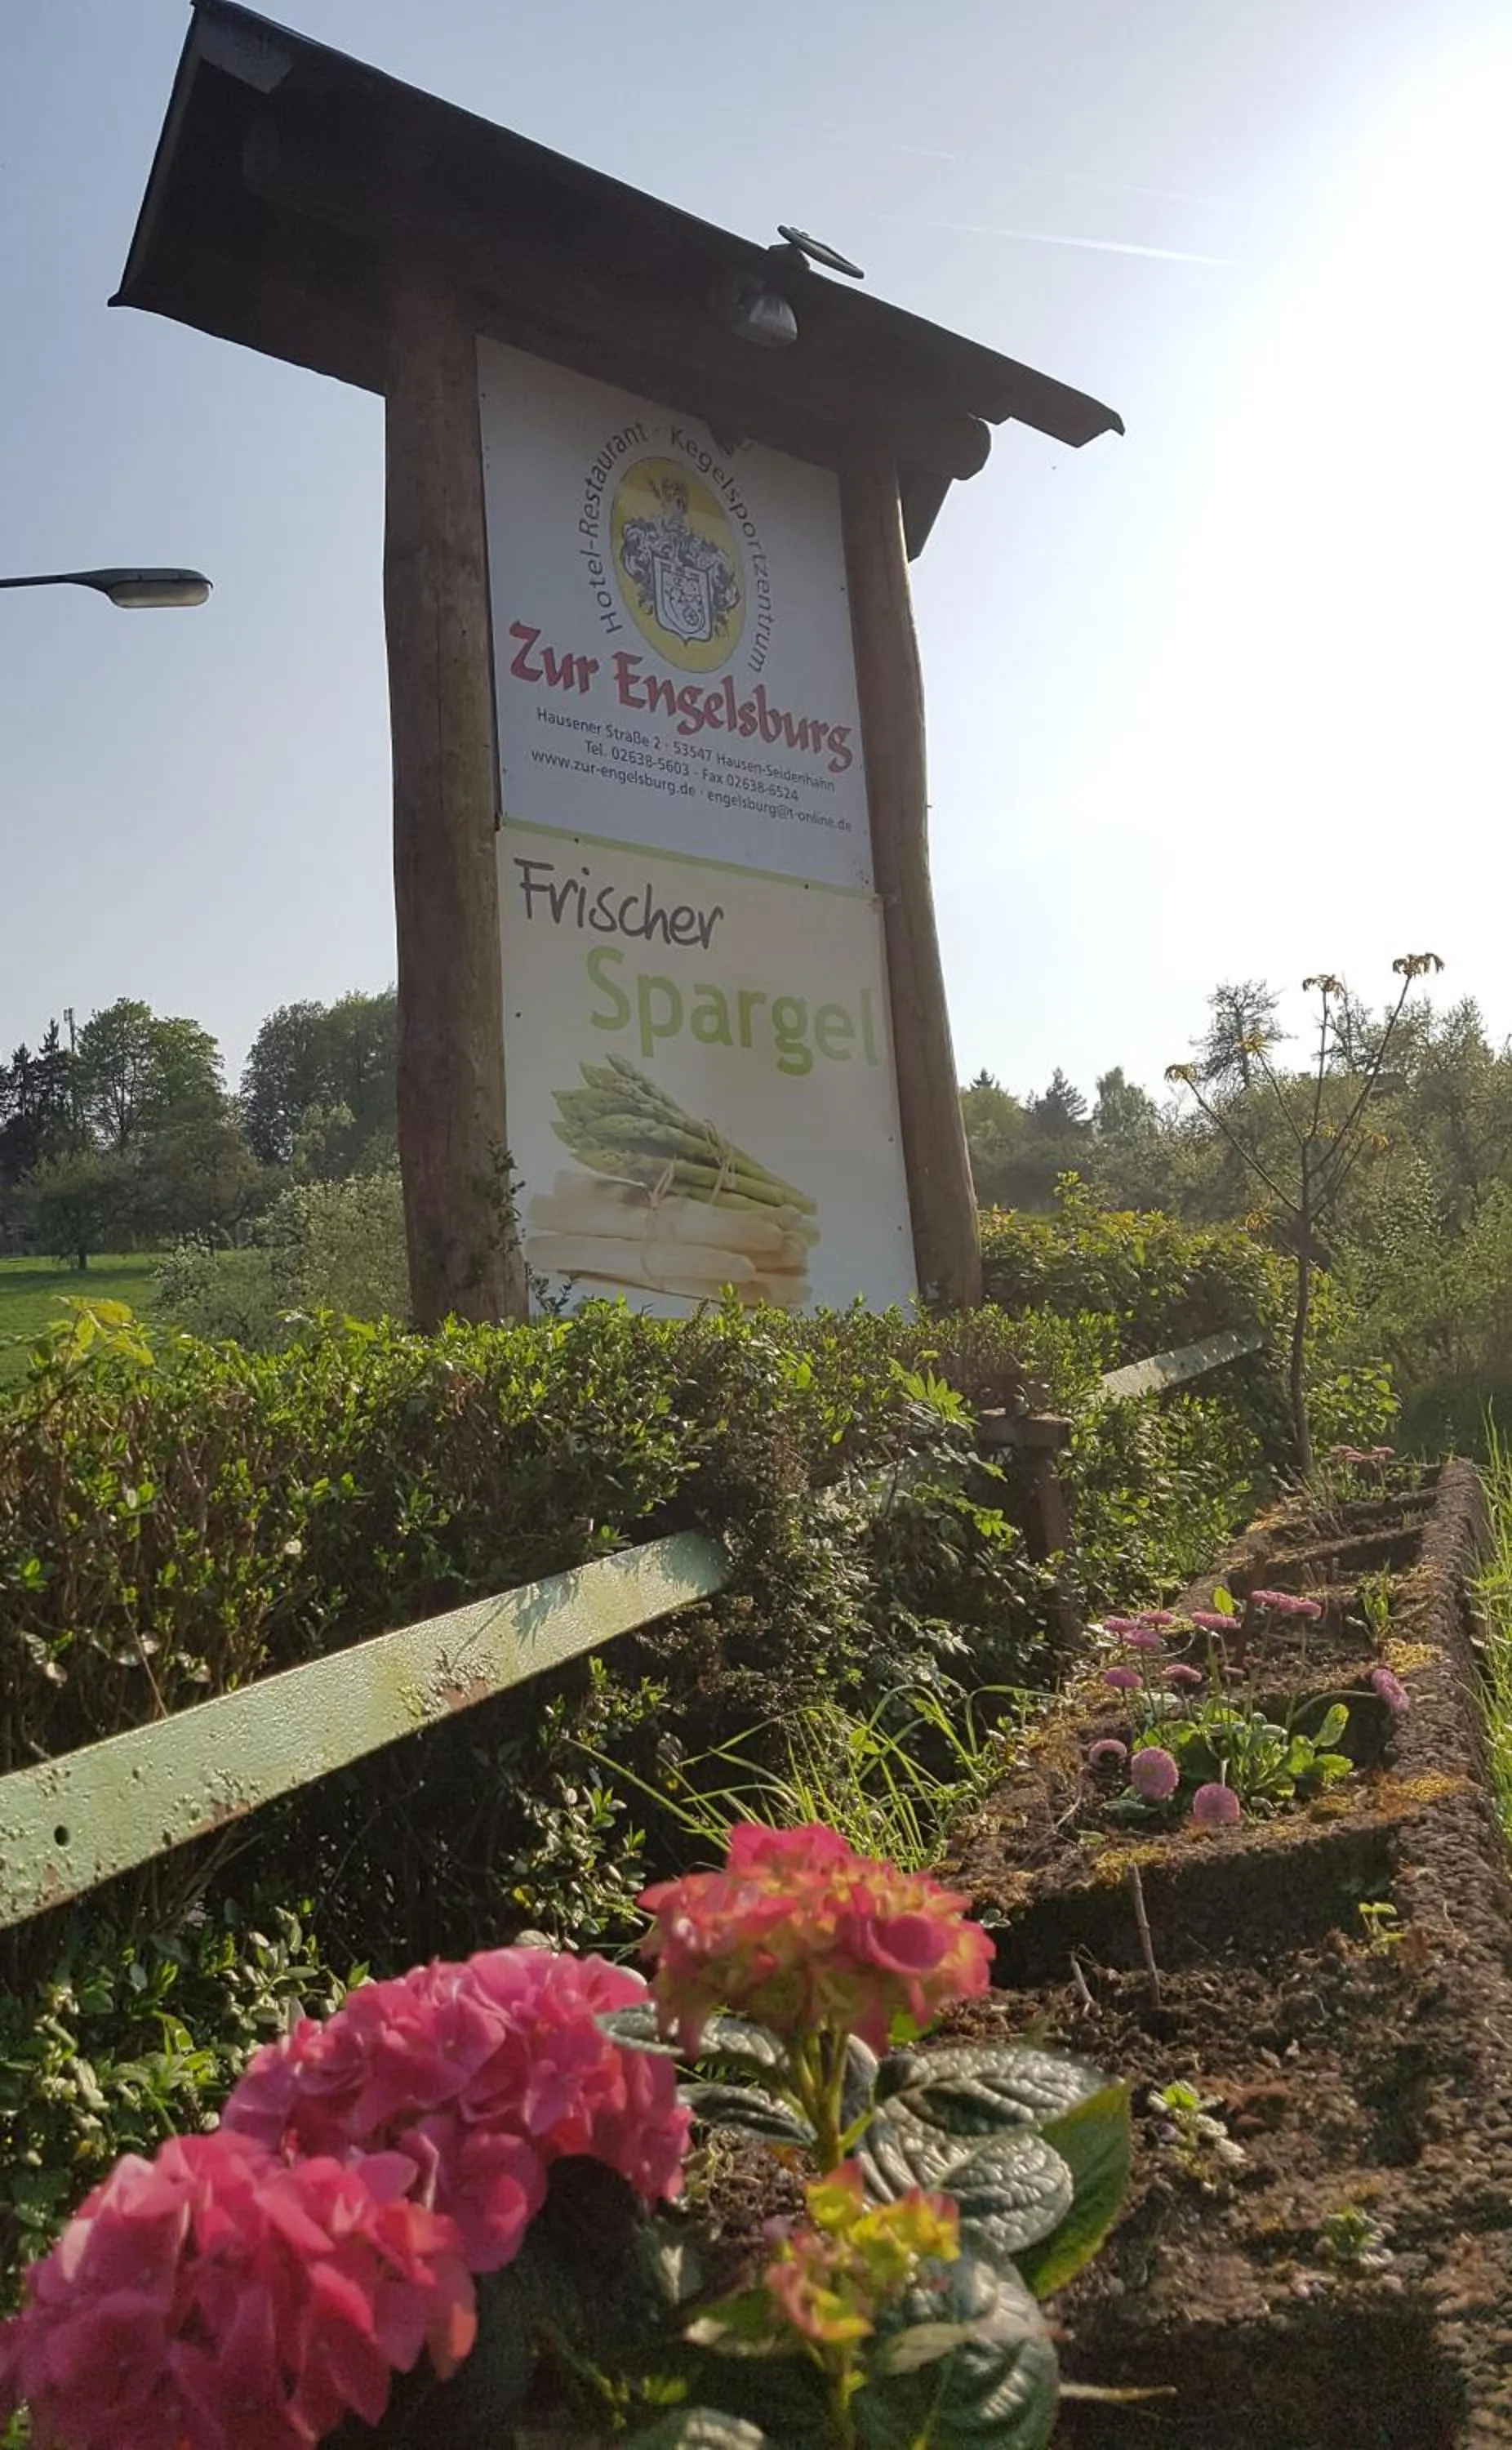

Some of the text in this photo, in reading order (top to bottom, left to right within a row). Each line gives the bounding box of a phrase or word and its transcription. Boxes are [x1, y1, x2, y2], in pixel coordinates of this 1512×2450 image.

[579, 421, 775, 674] Hotel-Restaurant Kegelsportzentrum
[508, 619, 853, 773] Zur Engelsburg
[531, 749, 852, 831] www.zur-engelsburg.de engelsburg@t-online.de
[536, 706, 835, 792] Hausener Straße 2 53547 Hausen-Seidenhahn
[585, 740, 607, 757] Tel.
[611, 746, 690, 776] 02638-5603
[702, 768, 723, 785] Fax
[513, 857, 725, 950] Frischer
[585, 945, 879, 1077] Spargel
